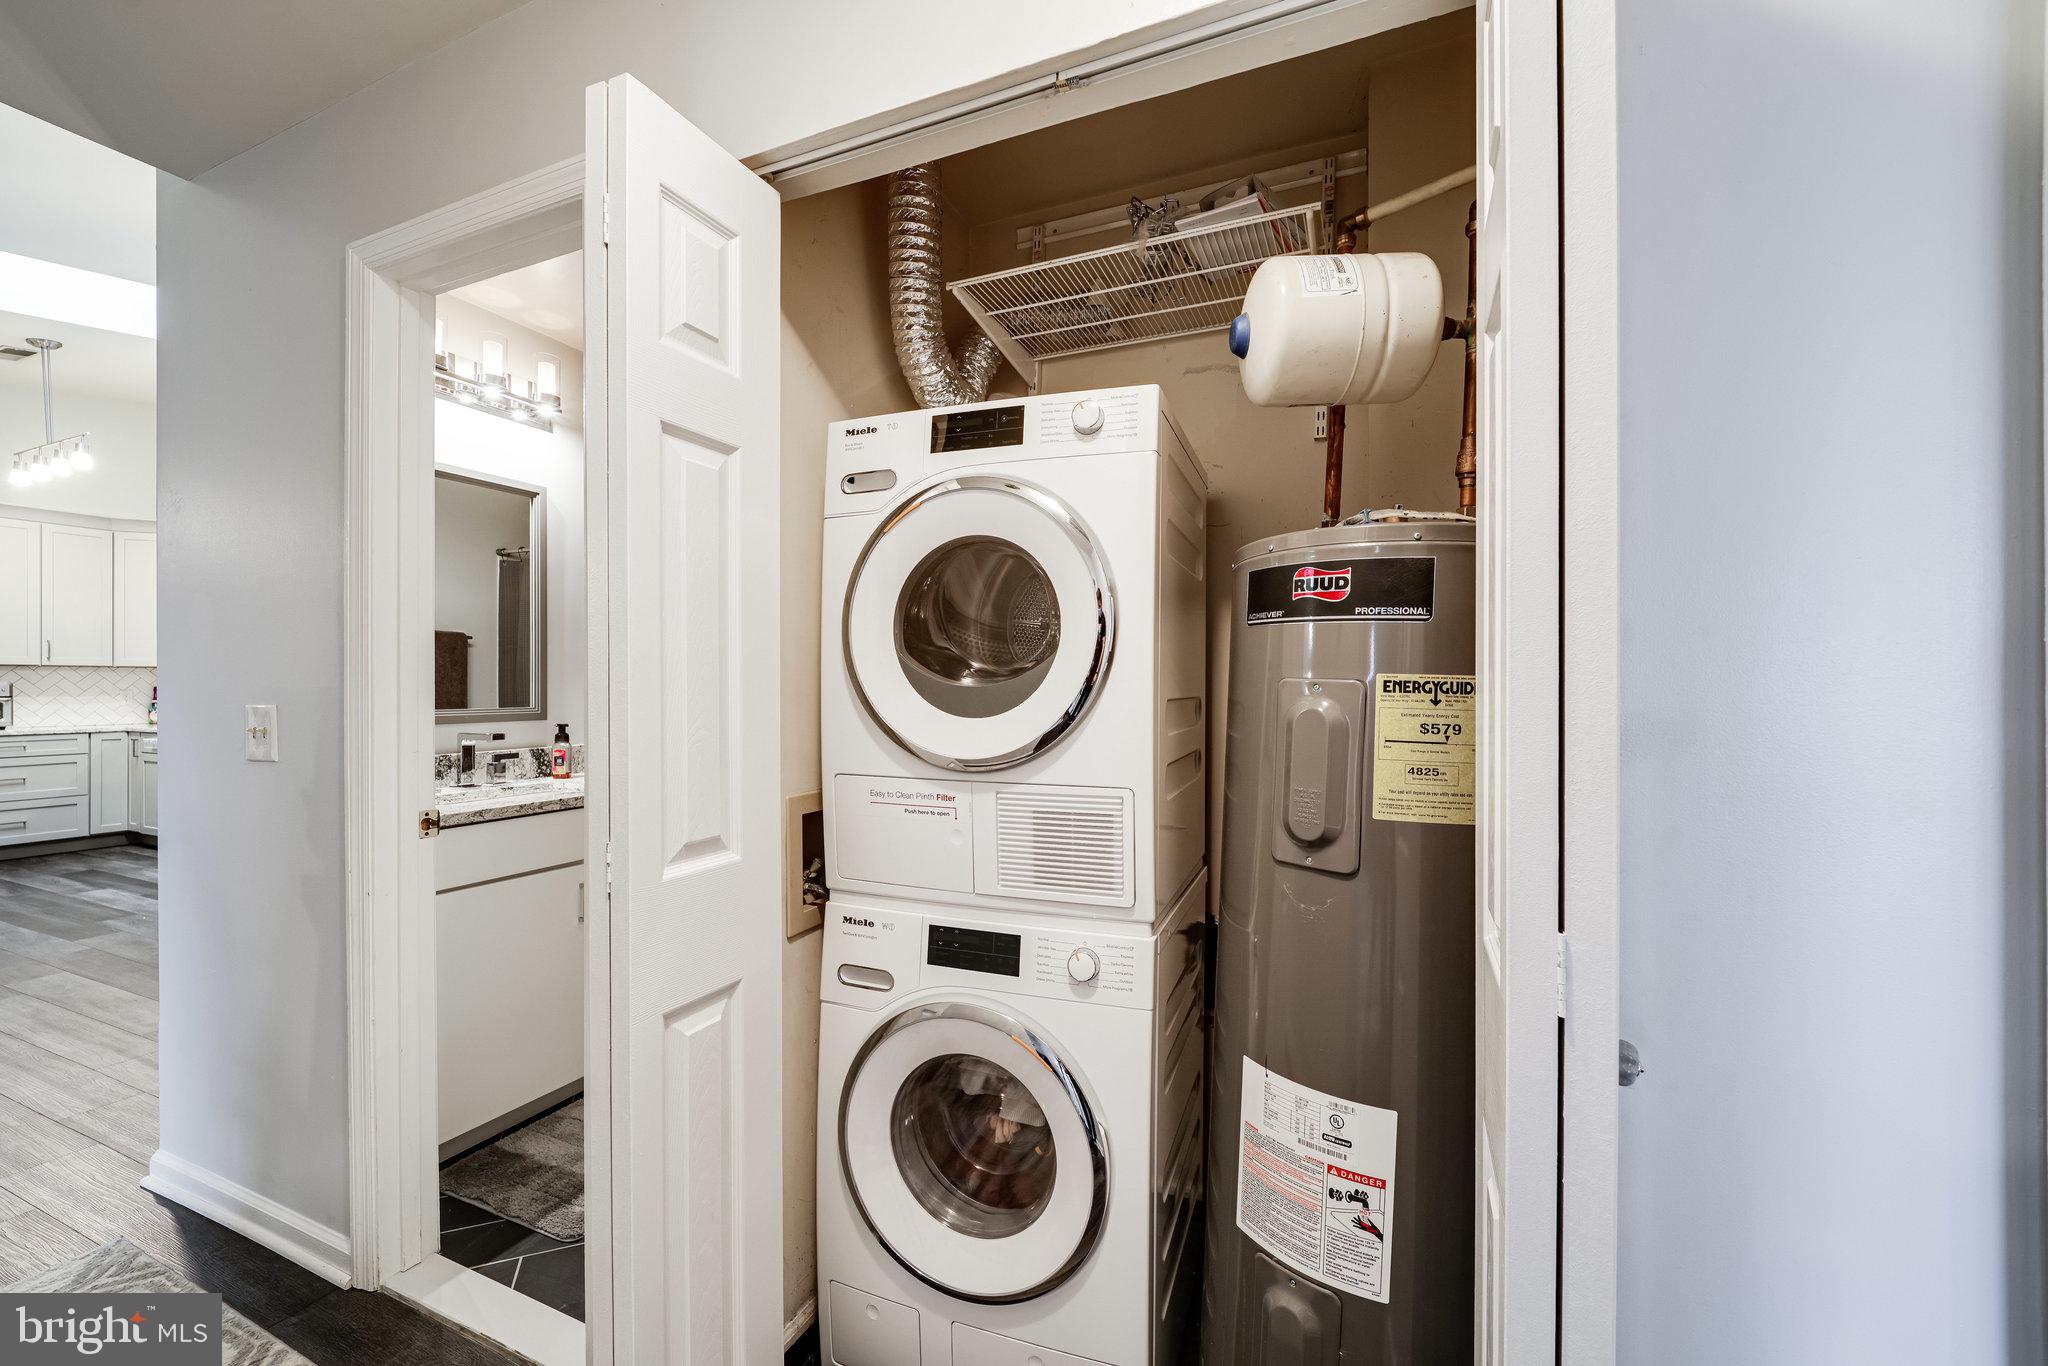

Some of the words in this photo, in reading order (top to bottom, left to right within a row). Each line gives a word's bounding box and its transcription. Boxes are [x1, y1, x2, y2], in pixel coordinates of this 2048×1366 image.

[846, 427, 877, 437] Miele
[1294, 576, 1349, 592] RUUD
[1248, 611, 1283, 620] ACHIEVER
[1355, 607, 1429, 615] PROFESSIONAL
[1383, 680, 1475, 697] ENERGYGUID
[1420, 723, 1462, 736] $579
[1408, 767, 1440, 777] 4825
[869, 790, 886, 799] Easy
[895, 791, 914, 799] Clean
[916, 792, 934, 801] Plinth
[936, 793, 956, 802] Filter
[842, 916, 875, 928] Miele
[1341, 1170, 1382, 1187] DANGER
